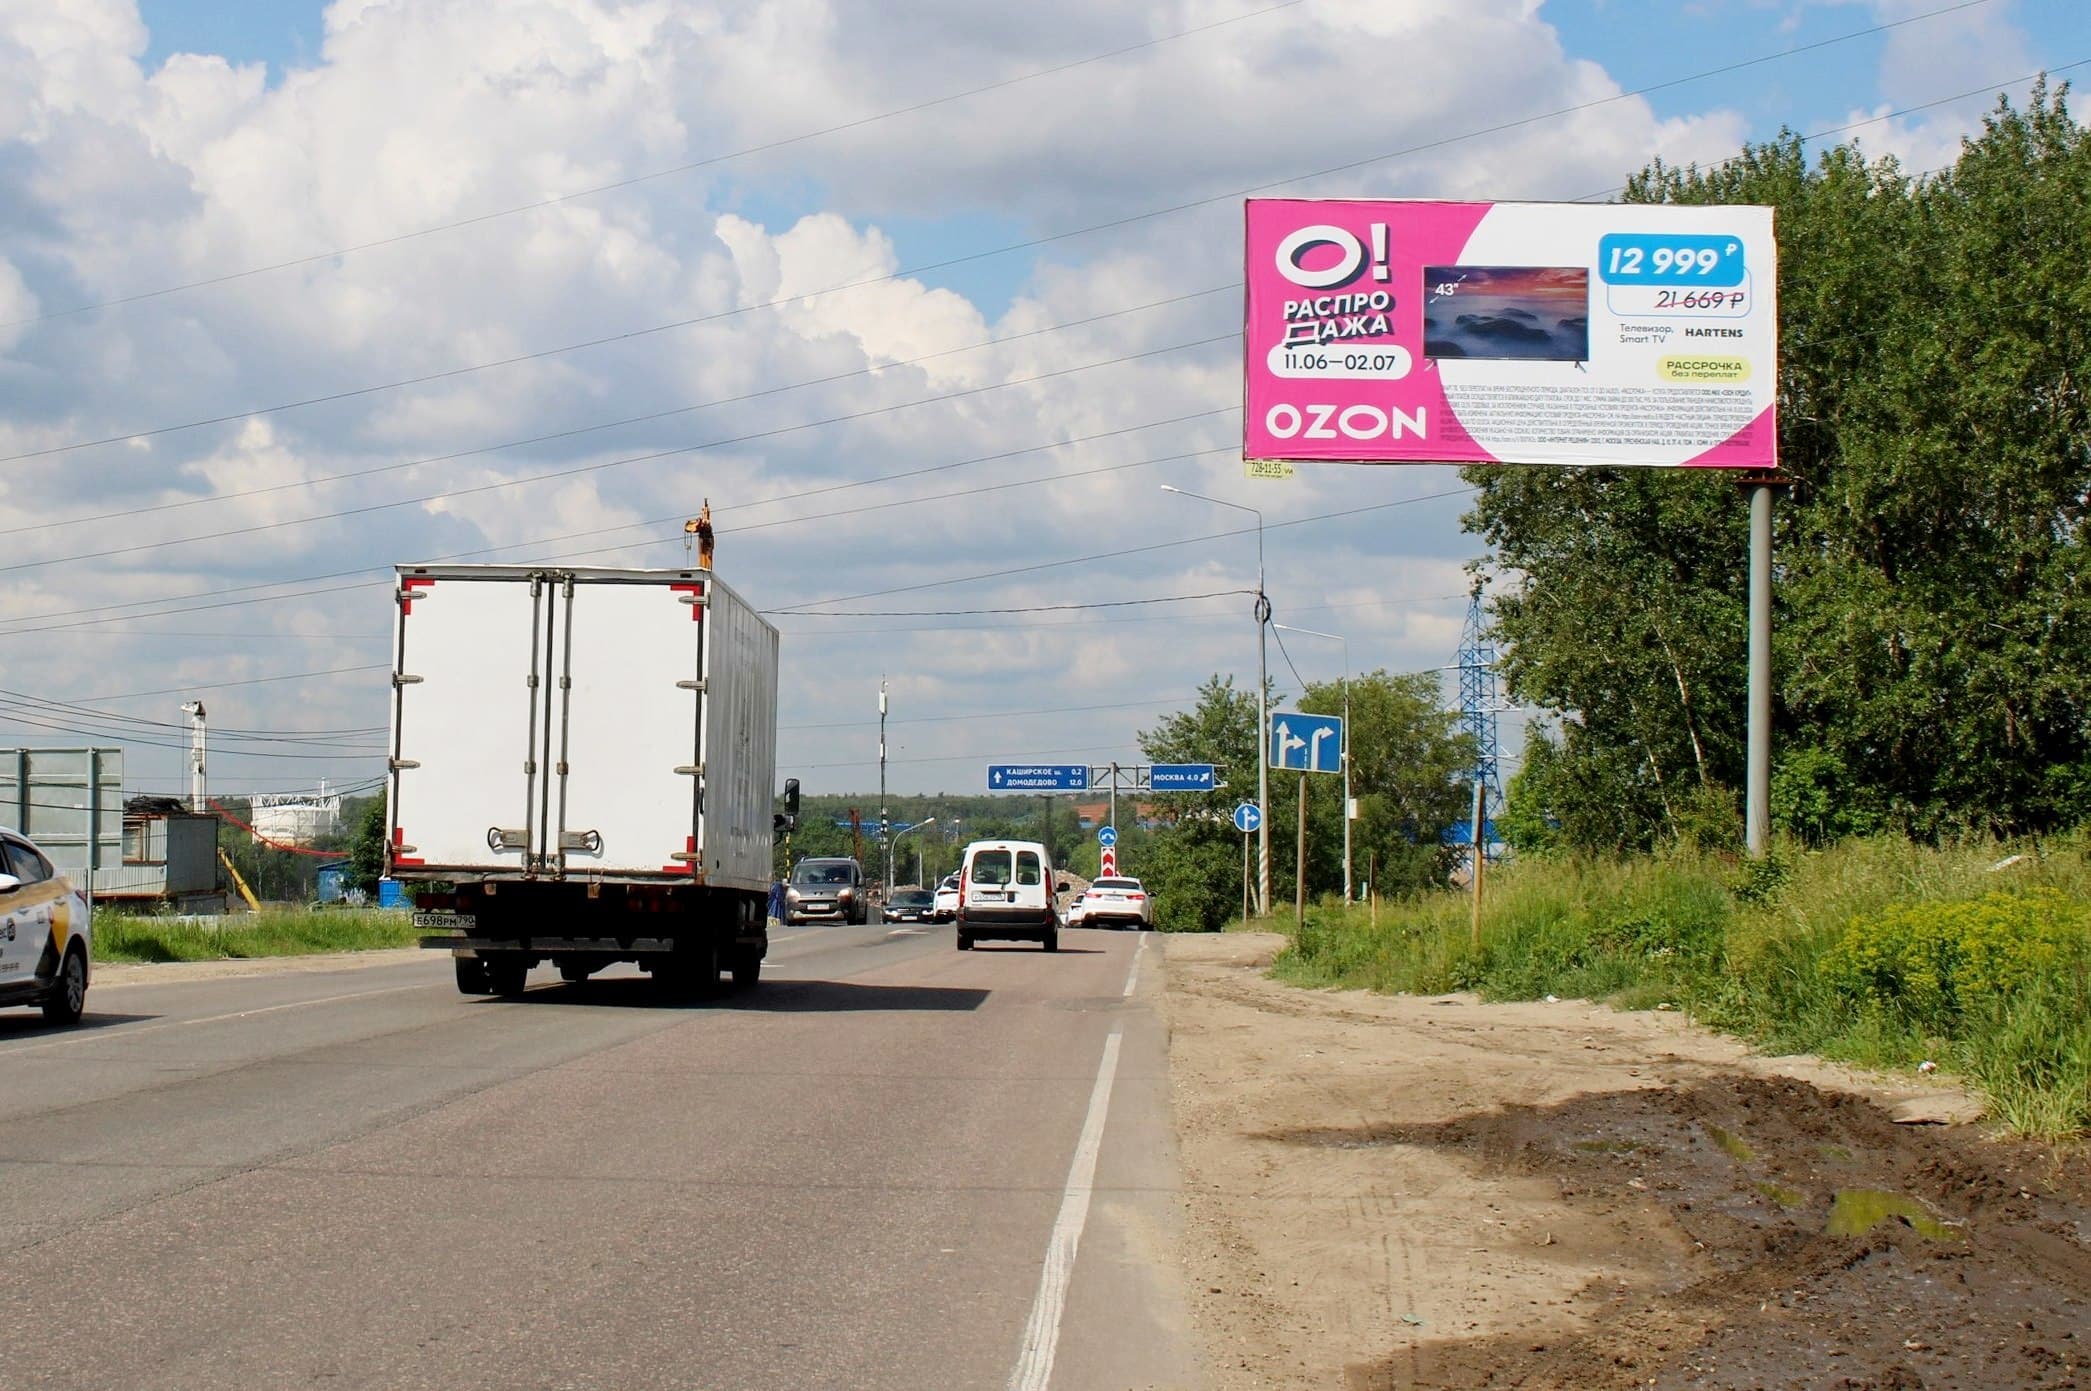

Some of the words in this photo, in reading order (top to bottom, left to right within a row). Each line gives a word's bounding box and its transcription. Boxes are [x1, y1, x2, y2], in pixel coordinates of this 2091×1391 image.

[1608, 247, 1643, 275] 12
[1652, 247, 1718, 275] 999
[1283, 290, 1391, 321] РАСПРО
[1655, 290, 1677, 308] 21
[1683, 291, 1724, 309] 669
[1281, 314, 1390, 347] ДАЖА
[1619, 323, 1674, 334] Телевизор,
[1685, 328, 1744, 338] HARTENS
[1619, 334, 1649, 344] Smart
[1653, 335, 1666, 344] TV
[1666, 361, 1743, 370] РАССРОЧКА
[1691, 371, 1738, 379] переплат
[1265, 403, 1427, 440] OZON
